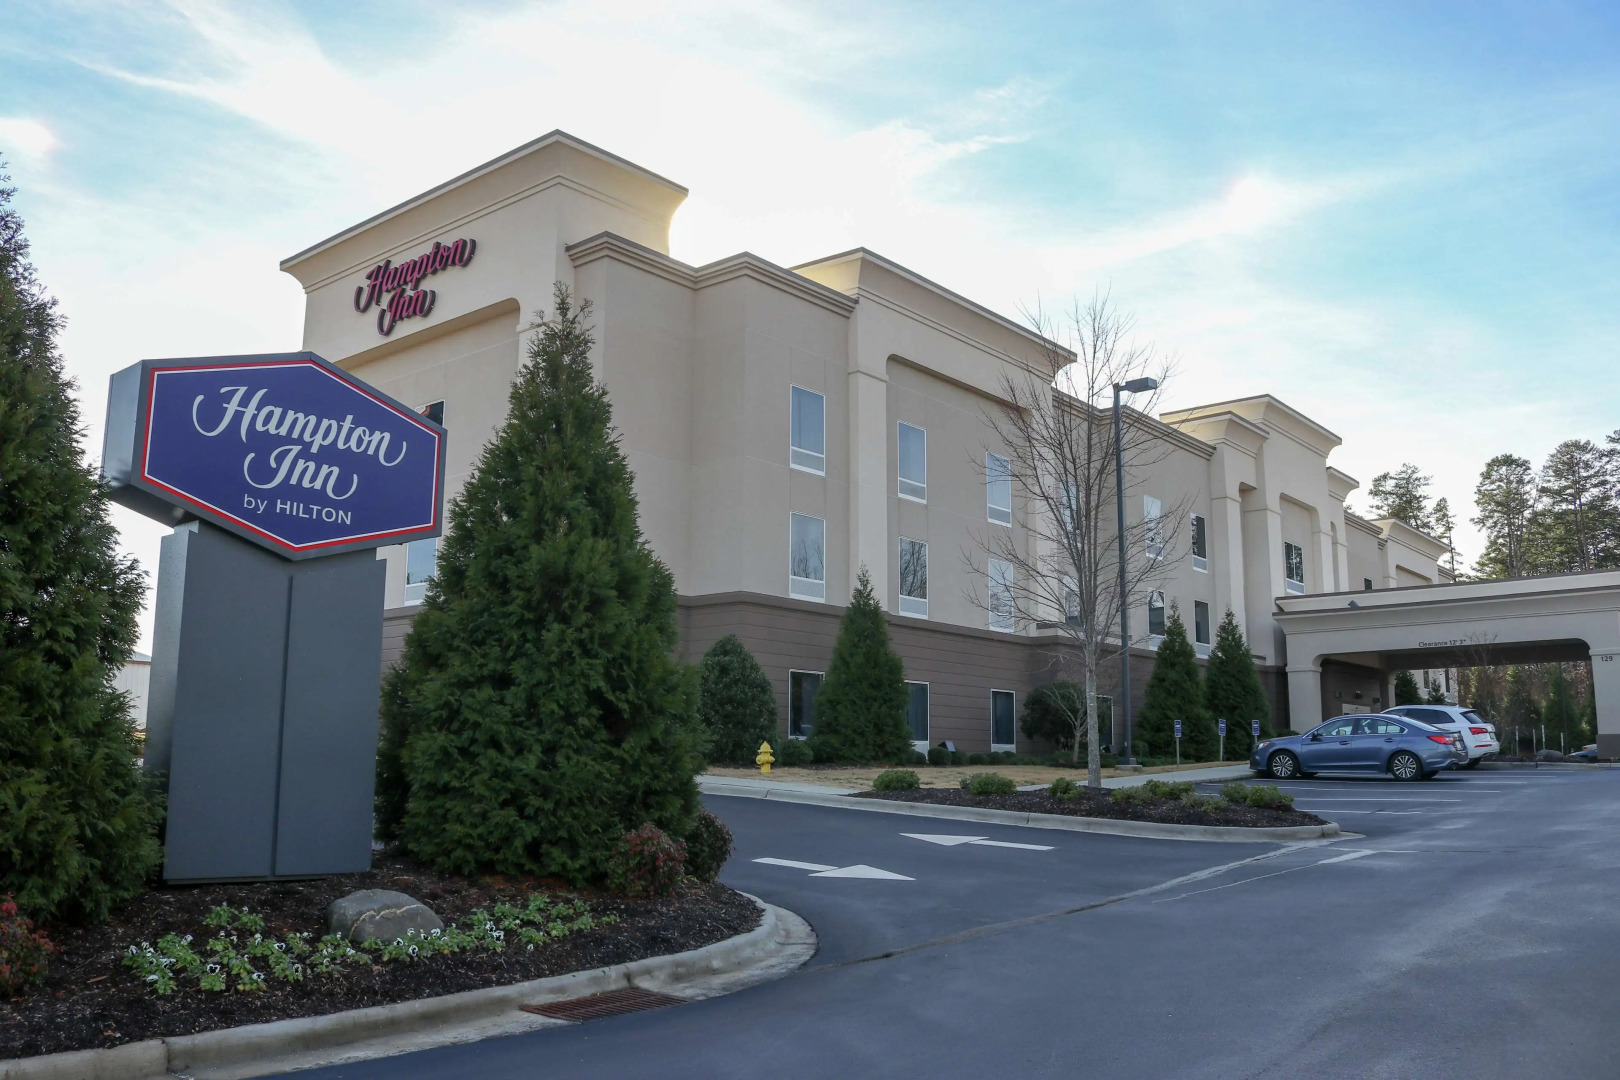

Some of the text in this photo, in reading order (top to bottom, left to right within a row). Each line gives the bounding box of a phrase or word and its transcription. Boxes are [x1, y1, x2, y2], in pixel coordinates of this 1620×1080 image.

[353, 238, 477, 313] Hampton
[377, 287, 436, 336] Inn
[192, 386, 407, 466] Hampton
[243, 445, 358, 500] Inn
[243, 493, 352, 525] by HILTON
[1418, 640, 1448, 648] Clearance
